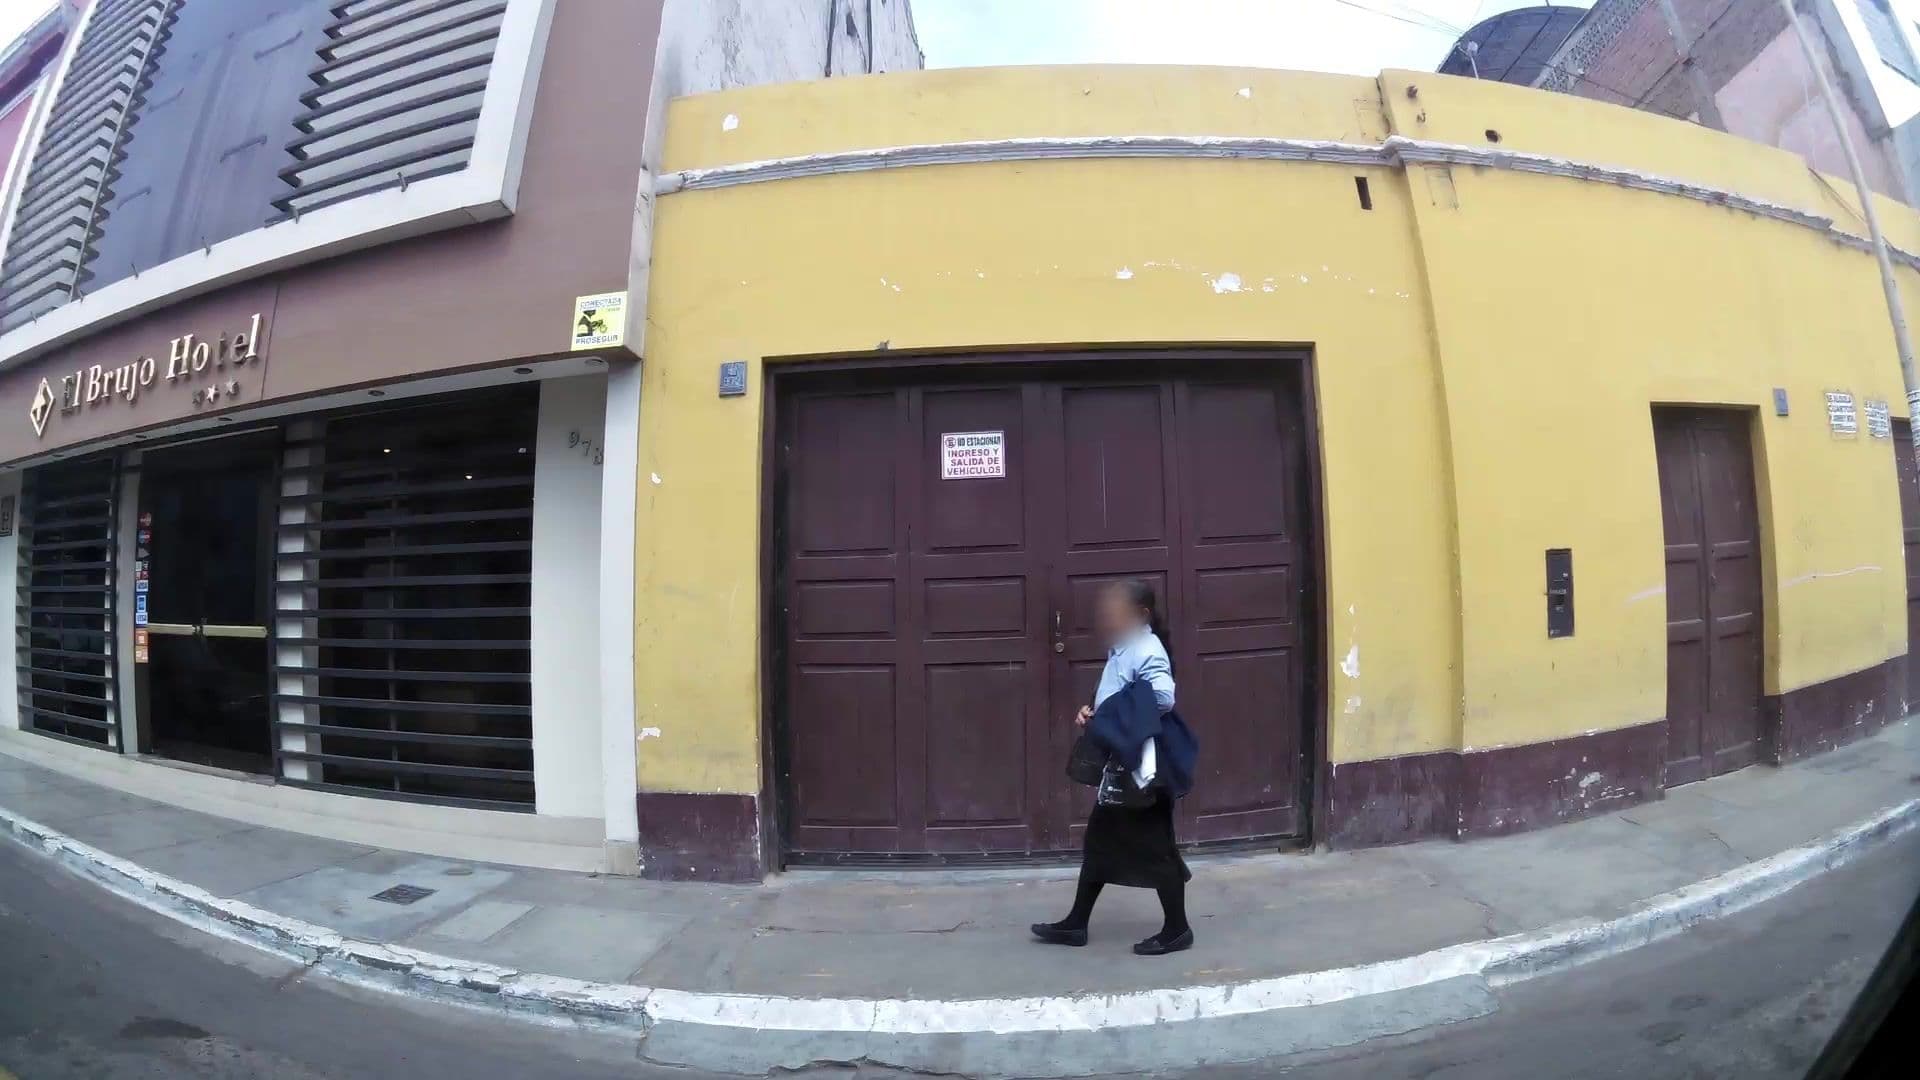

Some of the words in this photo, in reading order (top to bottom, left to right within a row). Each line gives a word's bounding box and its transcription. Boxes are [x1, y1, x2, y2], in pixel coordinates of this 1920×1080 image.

[87, 356, 155, 401] Brujo
[166, 313, 262, 380] Hotel
[957, 437, 965, 446] NO
[967, 436, 1000, 446] ESTACIONAR
[948, 449, 990, 457] INGRESO
[951, 458, 984, 466] SALIDA
[987, 457, 1000, 465] DE
[947, 466, 1001, 475] VEHICULOS
